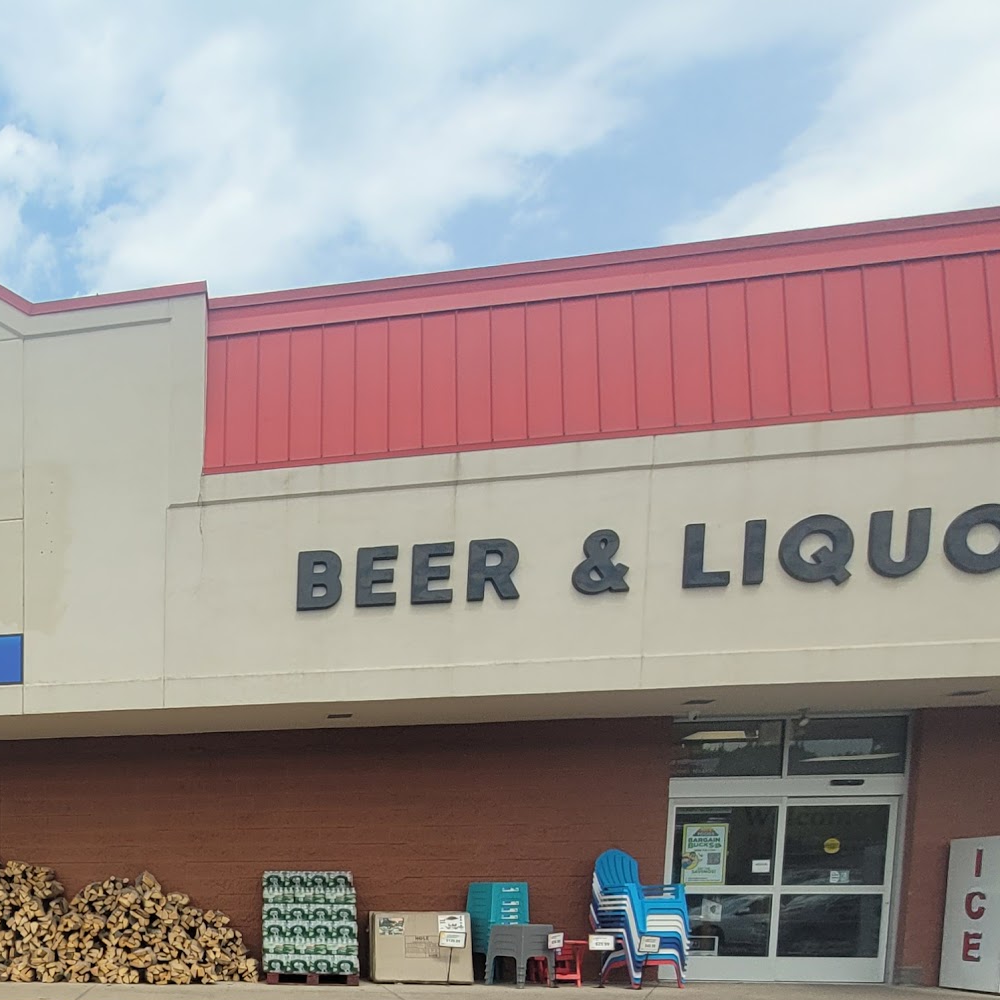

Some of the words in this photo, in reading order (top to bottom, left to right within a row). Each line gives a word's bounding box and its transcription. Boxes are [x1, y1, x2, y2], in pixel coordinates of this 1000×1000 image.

[296, 537, 520, 612] BEER
[571, 528, 630, 596] &
[682, 502, 1000, 589] LIQUO
[962, 848, 986, 962] ICE
